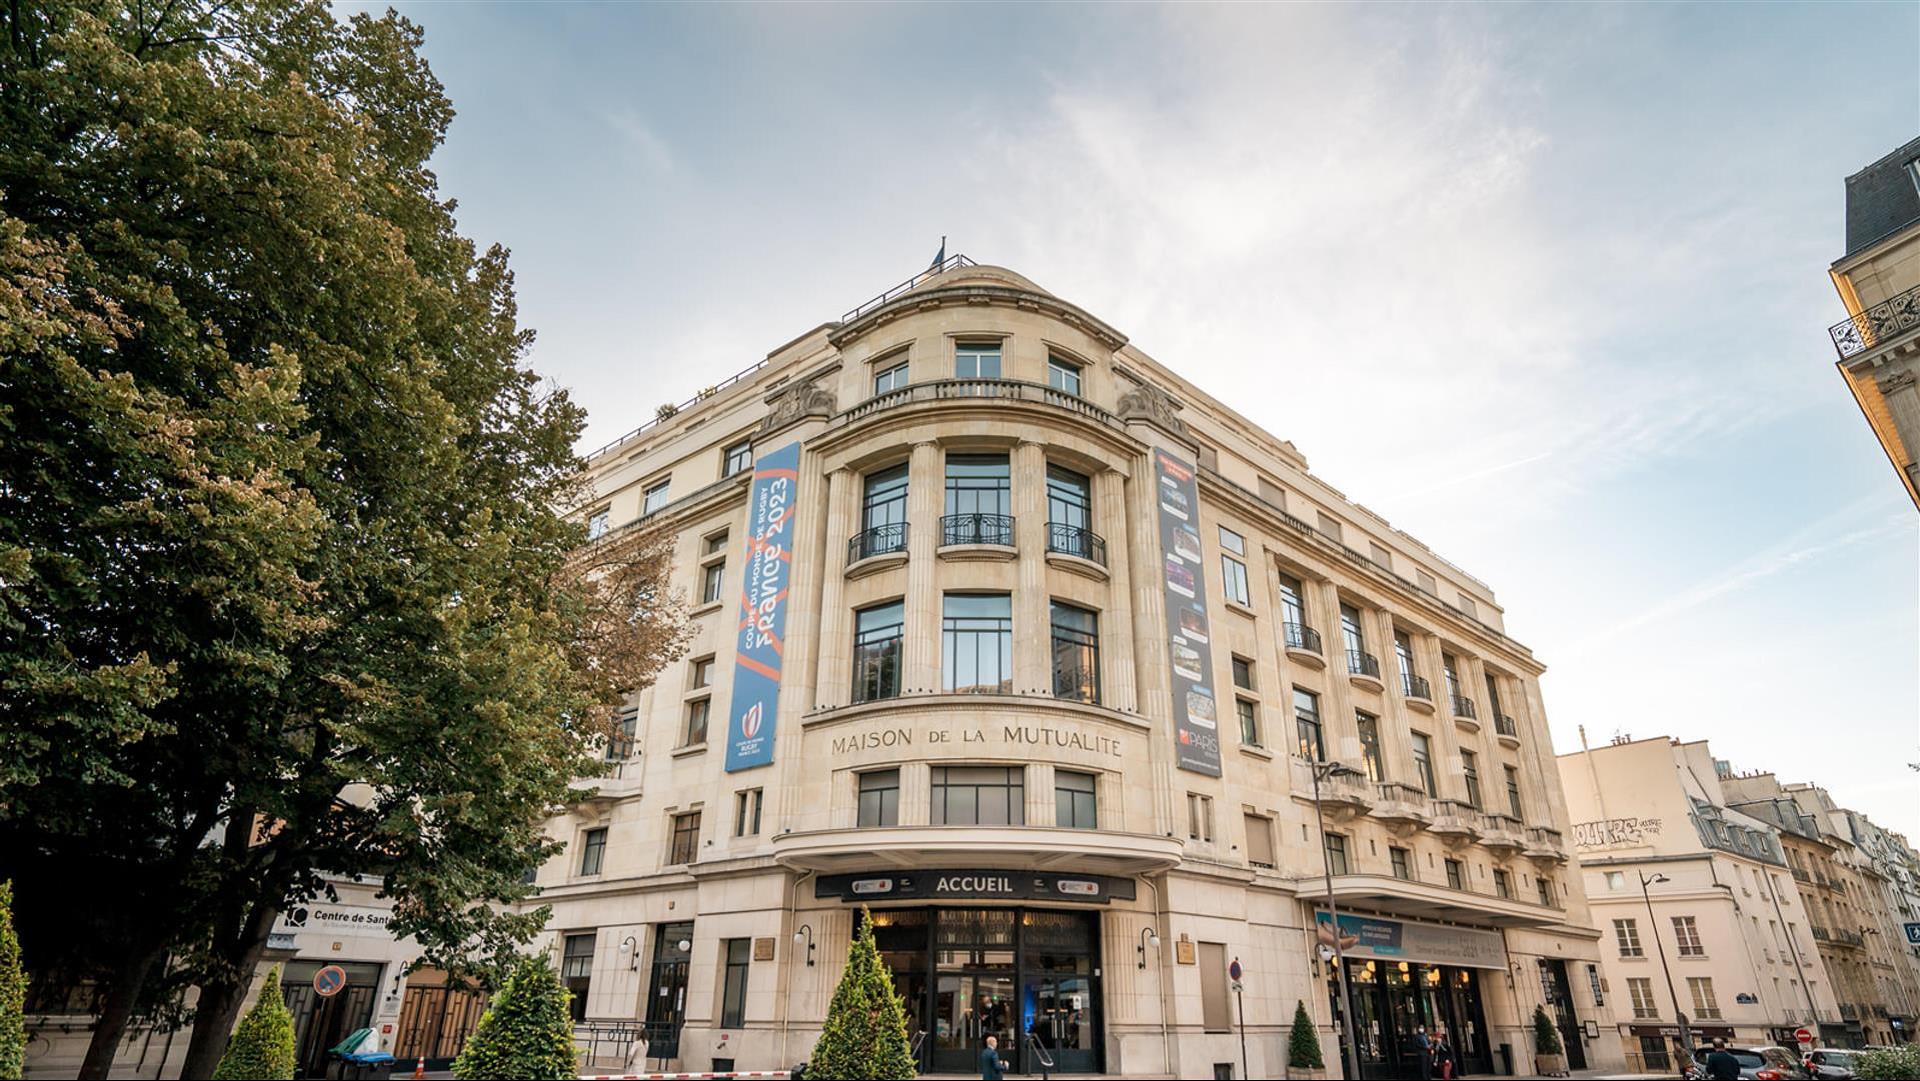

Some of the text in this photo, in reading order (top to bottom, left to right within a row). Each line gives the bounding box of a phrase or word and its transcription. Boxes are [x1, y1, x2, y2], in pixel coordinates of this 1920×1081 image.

[766, 477, 787, 537] 2023
[745, 487, 769, 649] COUPE DU MONDE DE RUGBY
[831, 726, 1122, 757] MAISON DE LA MUTUALITE
[936, 877, 1013, 892] ACCUEIL
[314, 910, 349, 922] Centre
[351, 913, 365, 923] de
